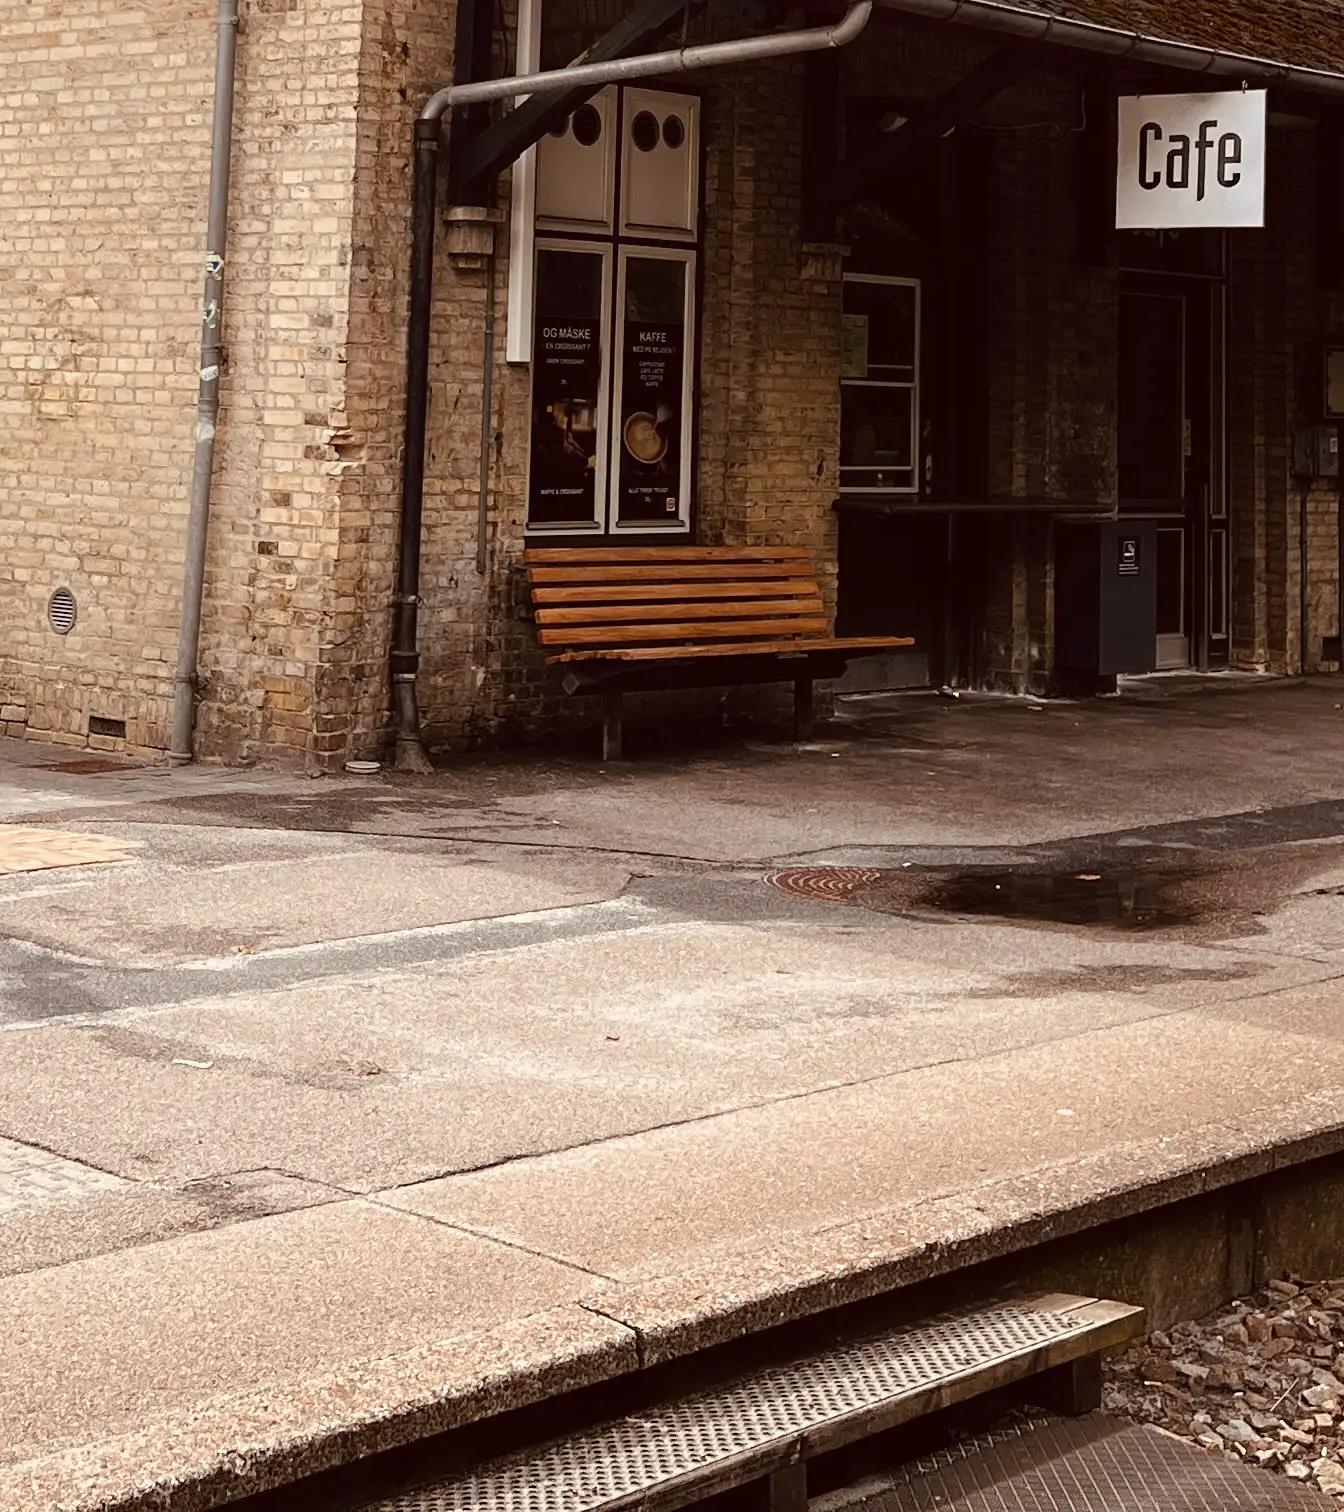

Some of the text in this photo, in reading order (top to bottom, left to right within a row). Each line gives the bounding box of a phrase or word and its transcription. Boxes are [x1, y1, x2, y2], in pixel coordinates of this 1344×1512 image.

[1138, 119, 1242, 202] Cafe
[543, 325, 591, 340] OG MÅSKE
[639, 331, 667, 343] KAFFE
